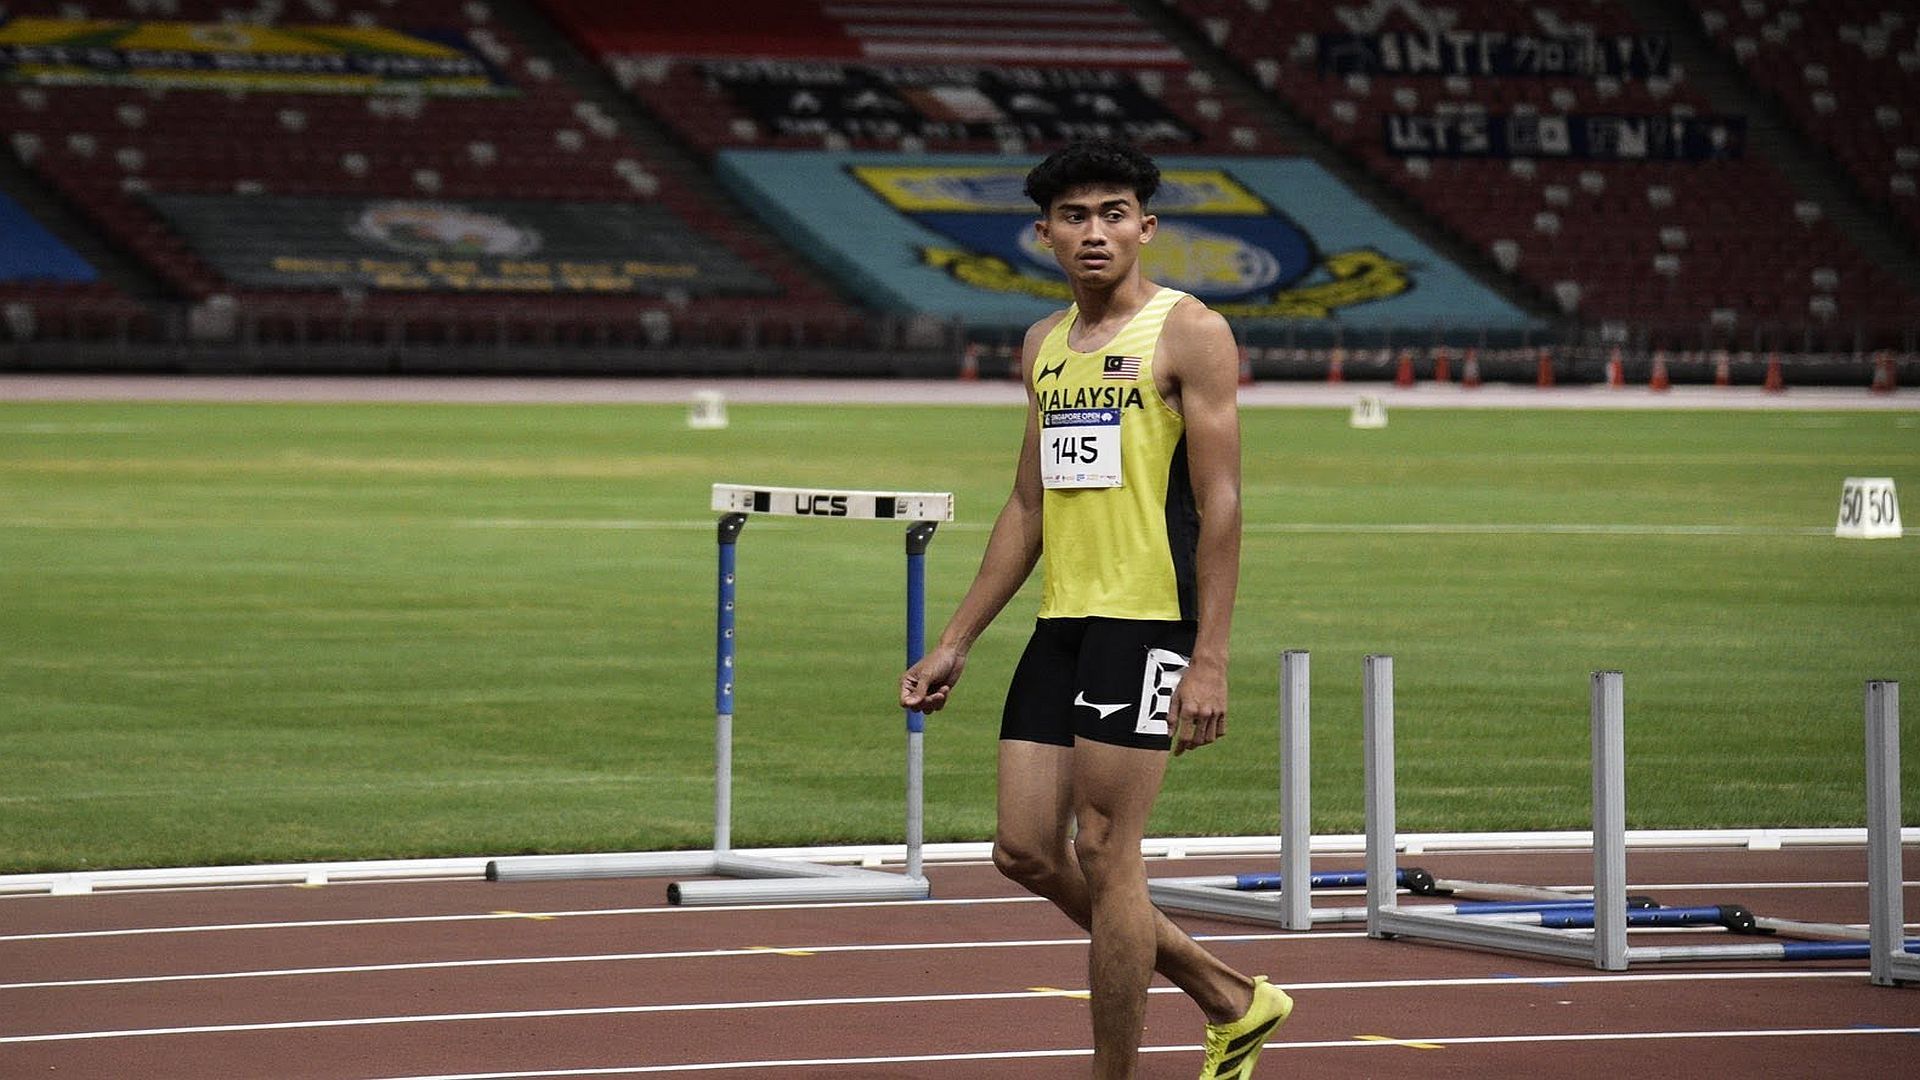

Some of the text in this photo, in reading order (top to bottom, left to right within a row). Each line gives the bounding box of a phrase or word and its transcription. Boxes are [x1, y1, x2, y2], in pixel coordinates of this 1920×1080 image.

[1037, 387, 1144, 411] MALAYSIA
[1052, 436, 1098, 464] 145
[796, 494, 847, 516] UCS
[1842, 486, 1895, 526] 50 50
